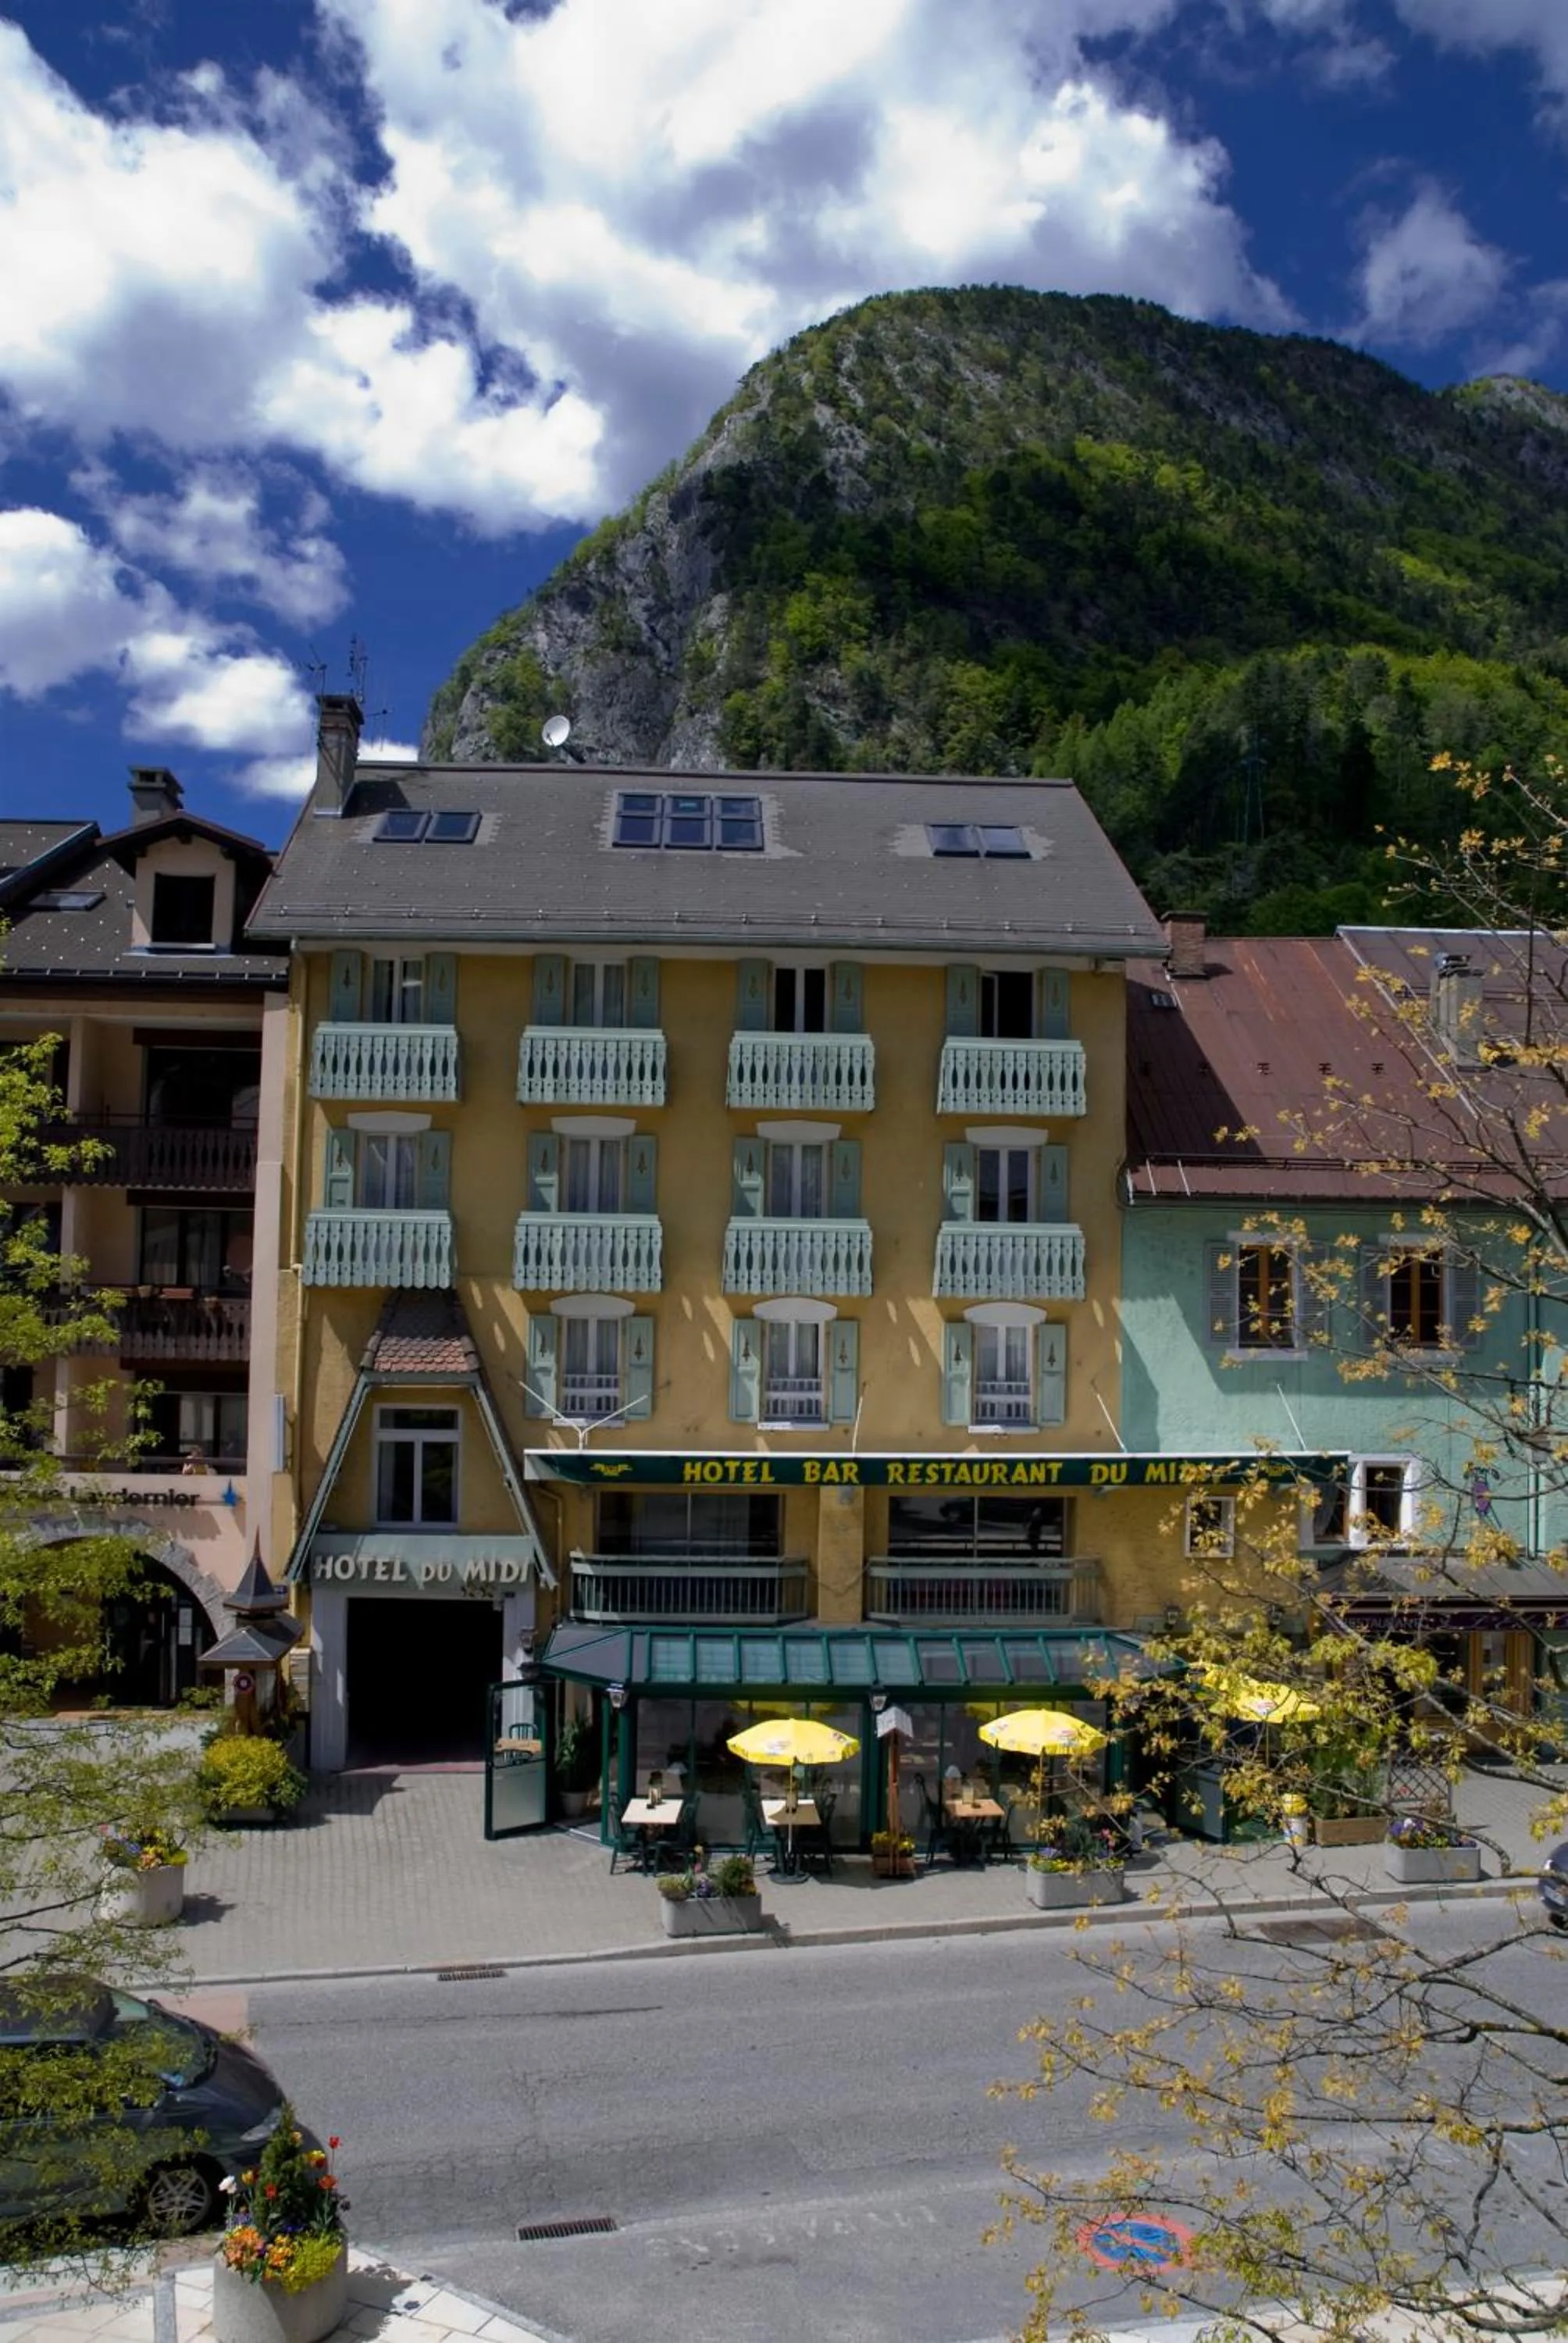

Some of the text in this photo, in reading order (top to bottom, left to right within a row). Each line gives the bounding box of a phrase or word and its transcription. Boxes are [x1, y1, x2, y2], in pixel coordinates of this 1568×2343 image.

[683, 1460, 775, 1484] HOTEL
[803, 1460, 858, 1484] BAR
[887, 1461, 1063, 1484] RESTAURANT
[1089, 1461, 1127, 1484] DU
[313, 1554, 530, 1584] HOTEL DU MIDI
